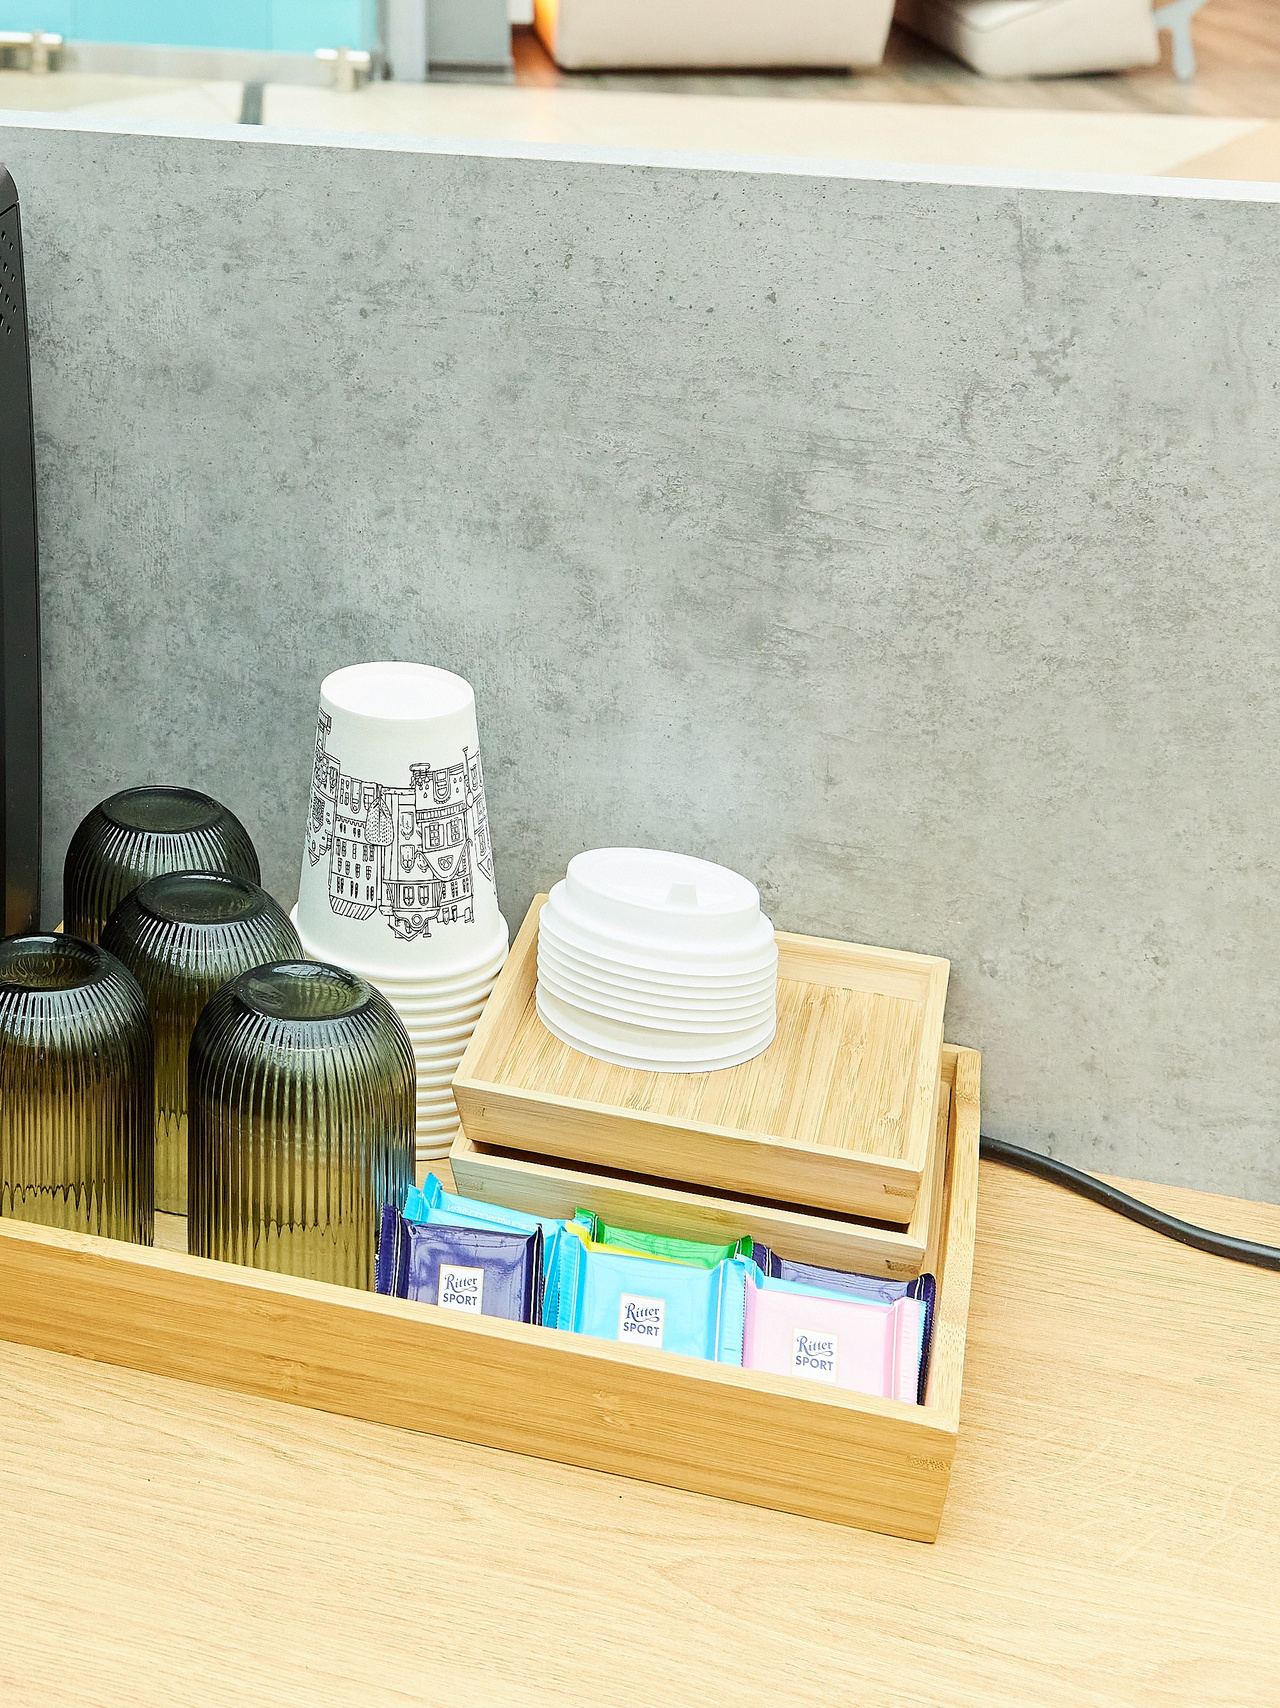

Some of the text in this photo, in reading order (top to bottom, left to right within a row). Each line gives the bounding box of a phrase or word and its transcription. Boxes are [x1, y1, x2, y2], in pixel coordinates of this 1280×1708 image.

[444, 1273, 478, 1293] Ritter
[442, 1292, 478, 1306] SPORT
[624, 1302, 660, 1323] Ritter
[623, 1321, 660, 1337] SPORT
[796, 1335, 834, 1357] Ritter
[795, 1355, 834, 1371] SPORT
